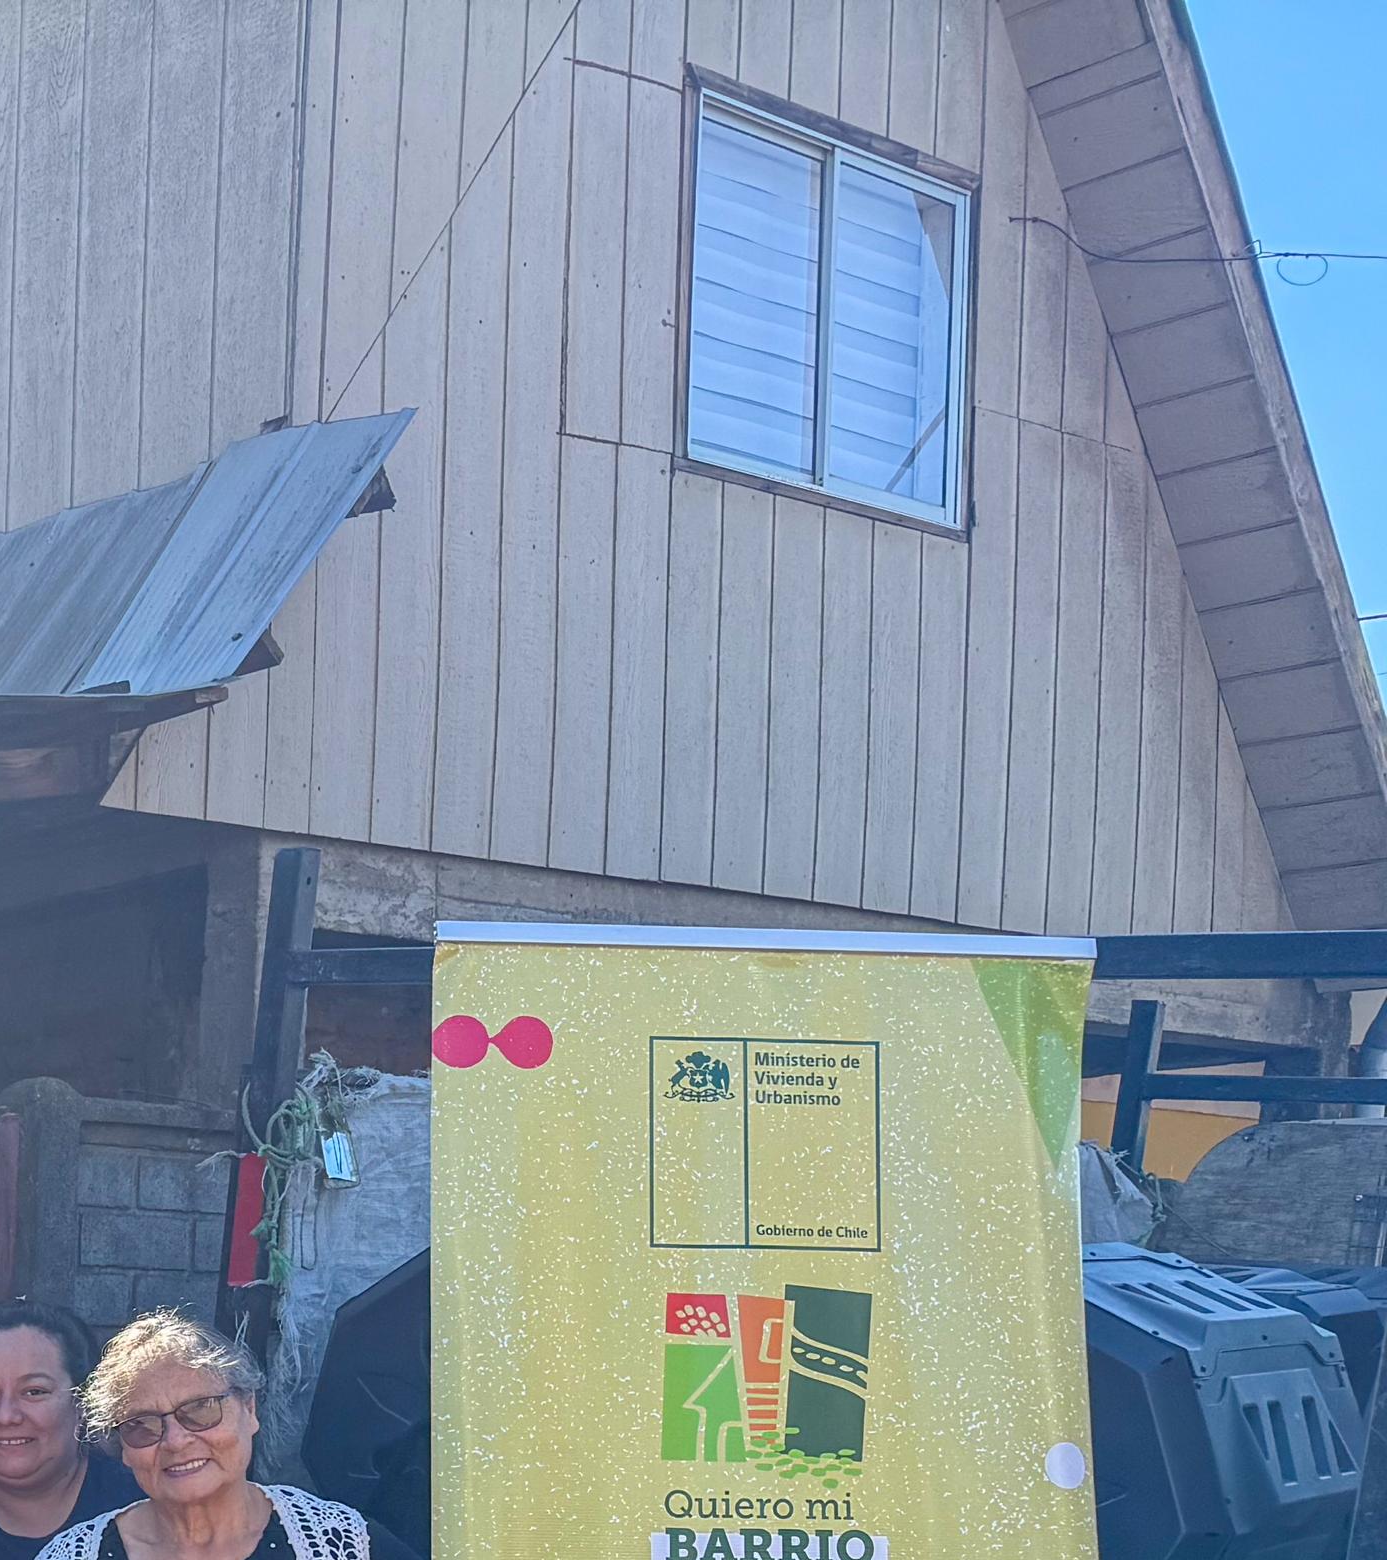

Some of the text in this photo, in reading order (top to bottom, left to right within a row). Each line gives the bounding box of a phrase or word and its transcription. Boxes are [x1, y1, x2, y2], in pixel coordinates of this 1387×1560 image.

[754, 1052, 860, 1069] Ministerio de
[755, 1071, 838, 1090] Vivienda y
[755, 1091, 841, 1106] Urbanismo
[756, 1224, 868, 1239] Gobierno de Chile
[664, 1490, 854, 1520] Quiero mi
